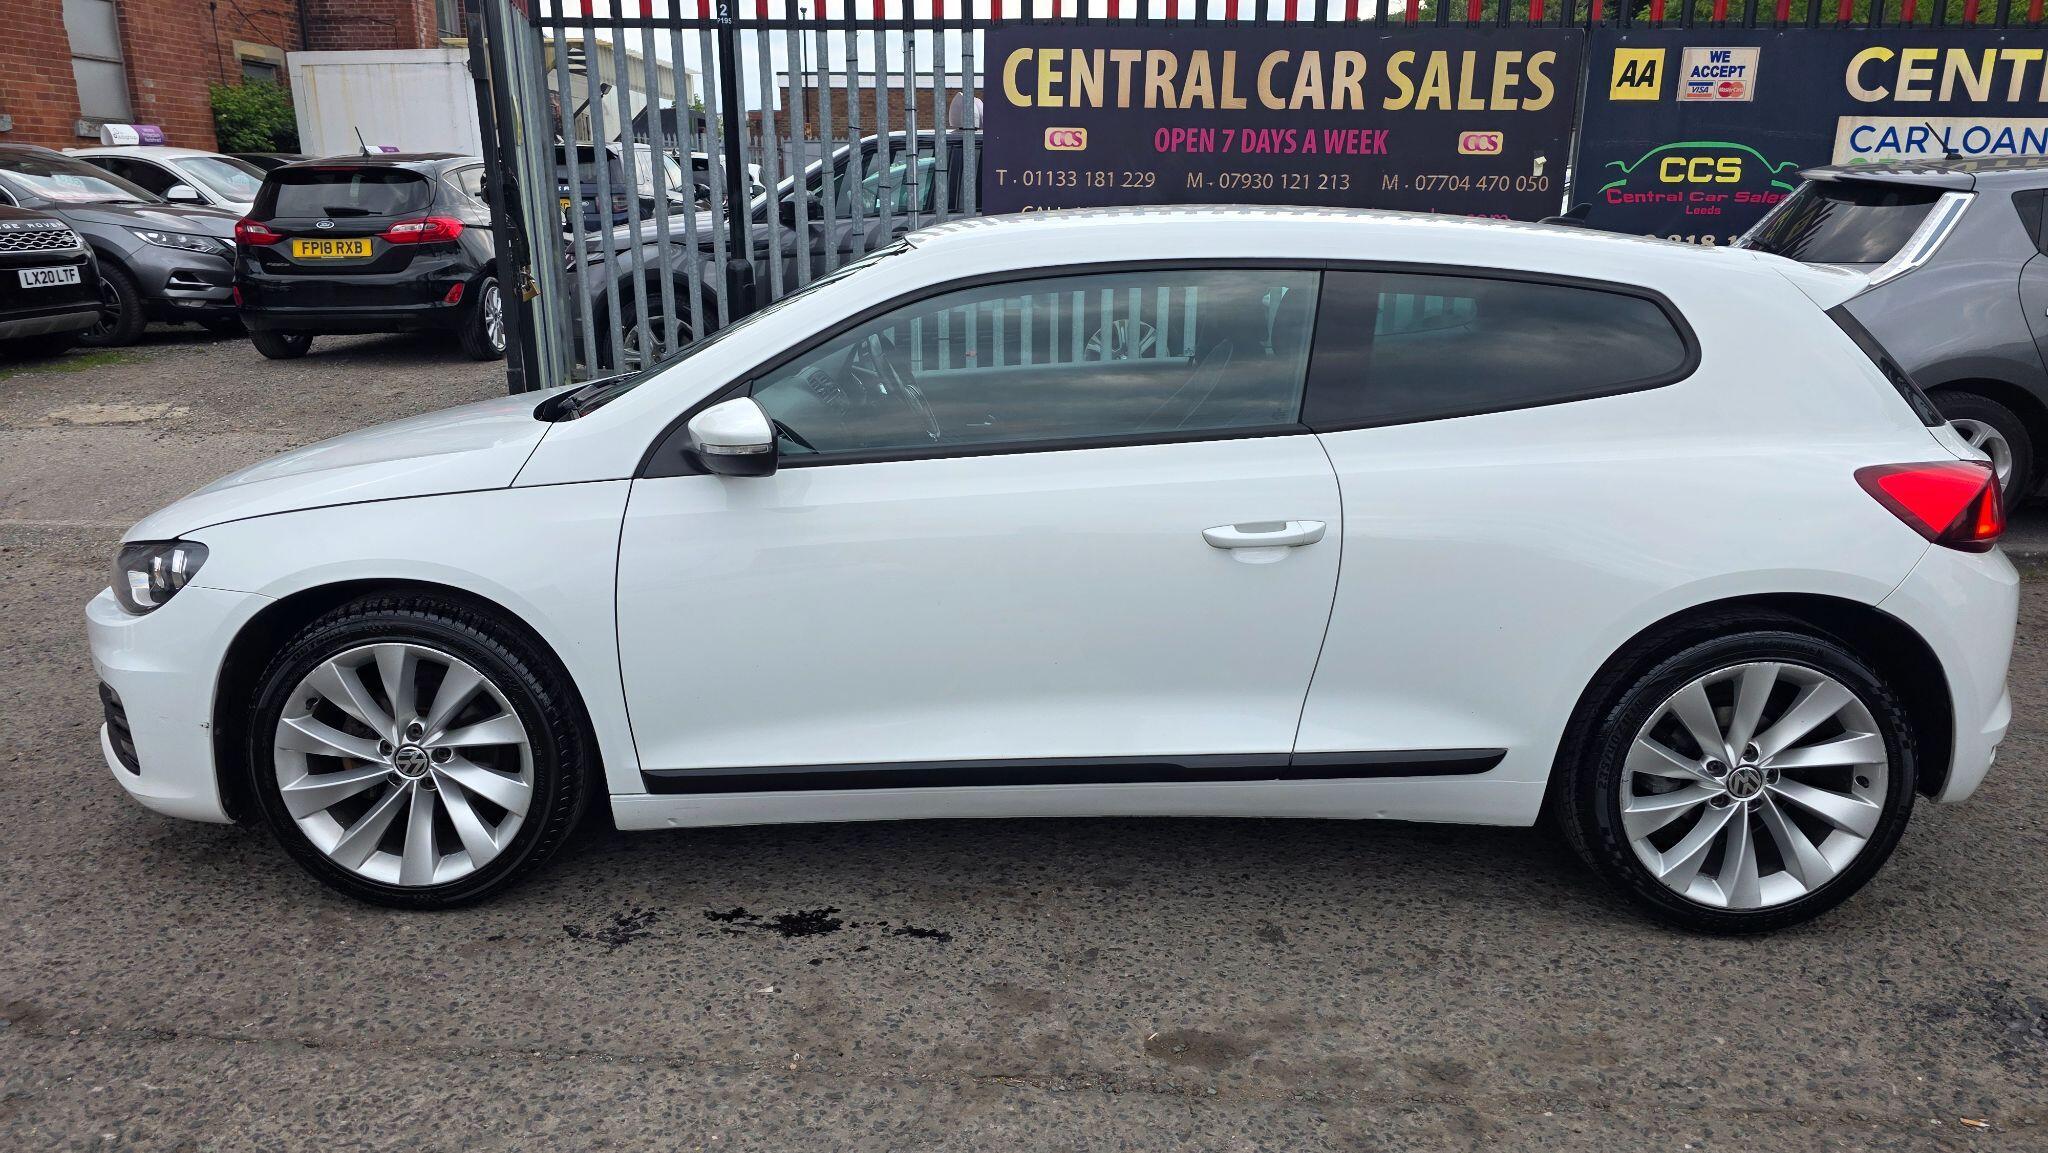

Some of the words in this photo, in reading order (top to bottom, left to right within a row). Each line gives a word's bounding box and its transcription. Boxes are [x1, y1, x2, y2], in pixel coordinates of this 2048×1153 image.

[720, 4, 727, 16] 2
[1709, 51, 1731, 63] WE
[1003, 47, 1247, 110] CENTRAL
[1256, 49, 1367, 110] CAR
[1382, 50, 1557, 111] SALES
[1616, 59, 1657, 87] AA
[1690, 65, 1746, 78] ACCEPT
[1846, 46, 2048, 102] CENT
[1049, 130, 1083, 148] CCS
[1154, 127, 1214, 153] OPEN
[1221, 129, 1235, 153] 7
[1241, 128, 1297, 154] DAYS
[1302, 129, 1317, 154] A
[1324, 129, 1389, 155] WEEK
[1463, 134, 1499, 152] CCS
[1850, 125, 1929, 153] CAR
[1023, 170, 1077, 187] 01133
[1085, 171, 1114, 187] 181
[1120, 172, 1156, 188] 229
[1659, 157, 1742, 183] CCS
[1219, 173, 1273, 189] 07930
[1282, 173, 1309, 190] 121
[1317, 173, 1350, 190] 213
[1415, 175, 1470, 191] 07704
[1476, 175, 1509, 192] 470
[1516, 176, 1549, 192] 050
[1606, 188, 1683, 204] Central
[1689, 191, 1728, 203] Car
[1685, 205, 1721, 215] Leeds
[302, 241, 332, 255] FP18
[336, 241, 363, 255] RXB
[24, 270, 55, 286] LX20
[56, 268, 75, 283] LTF
